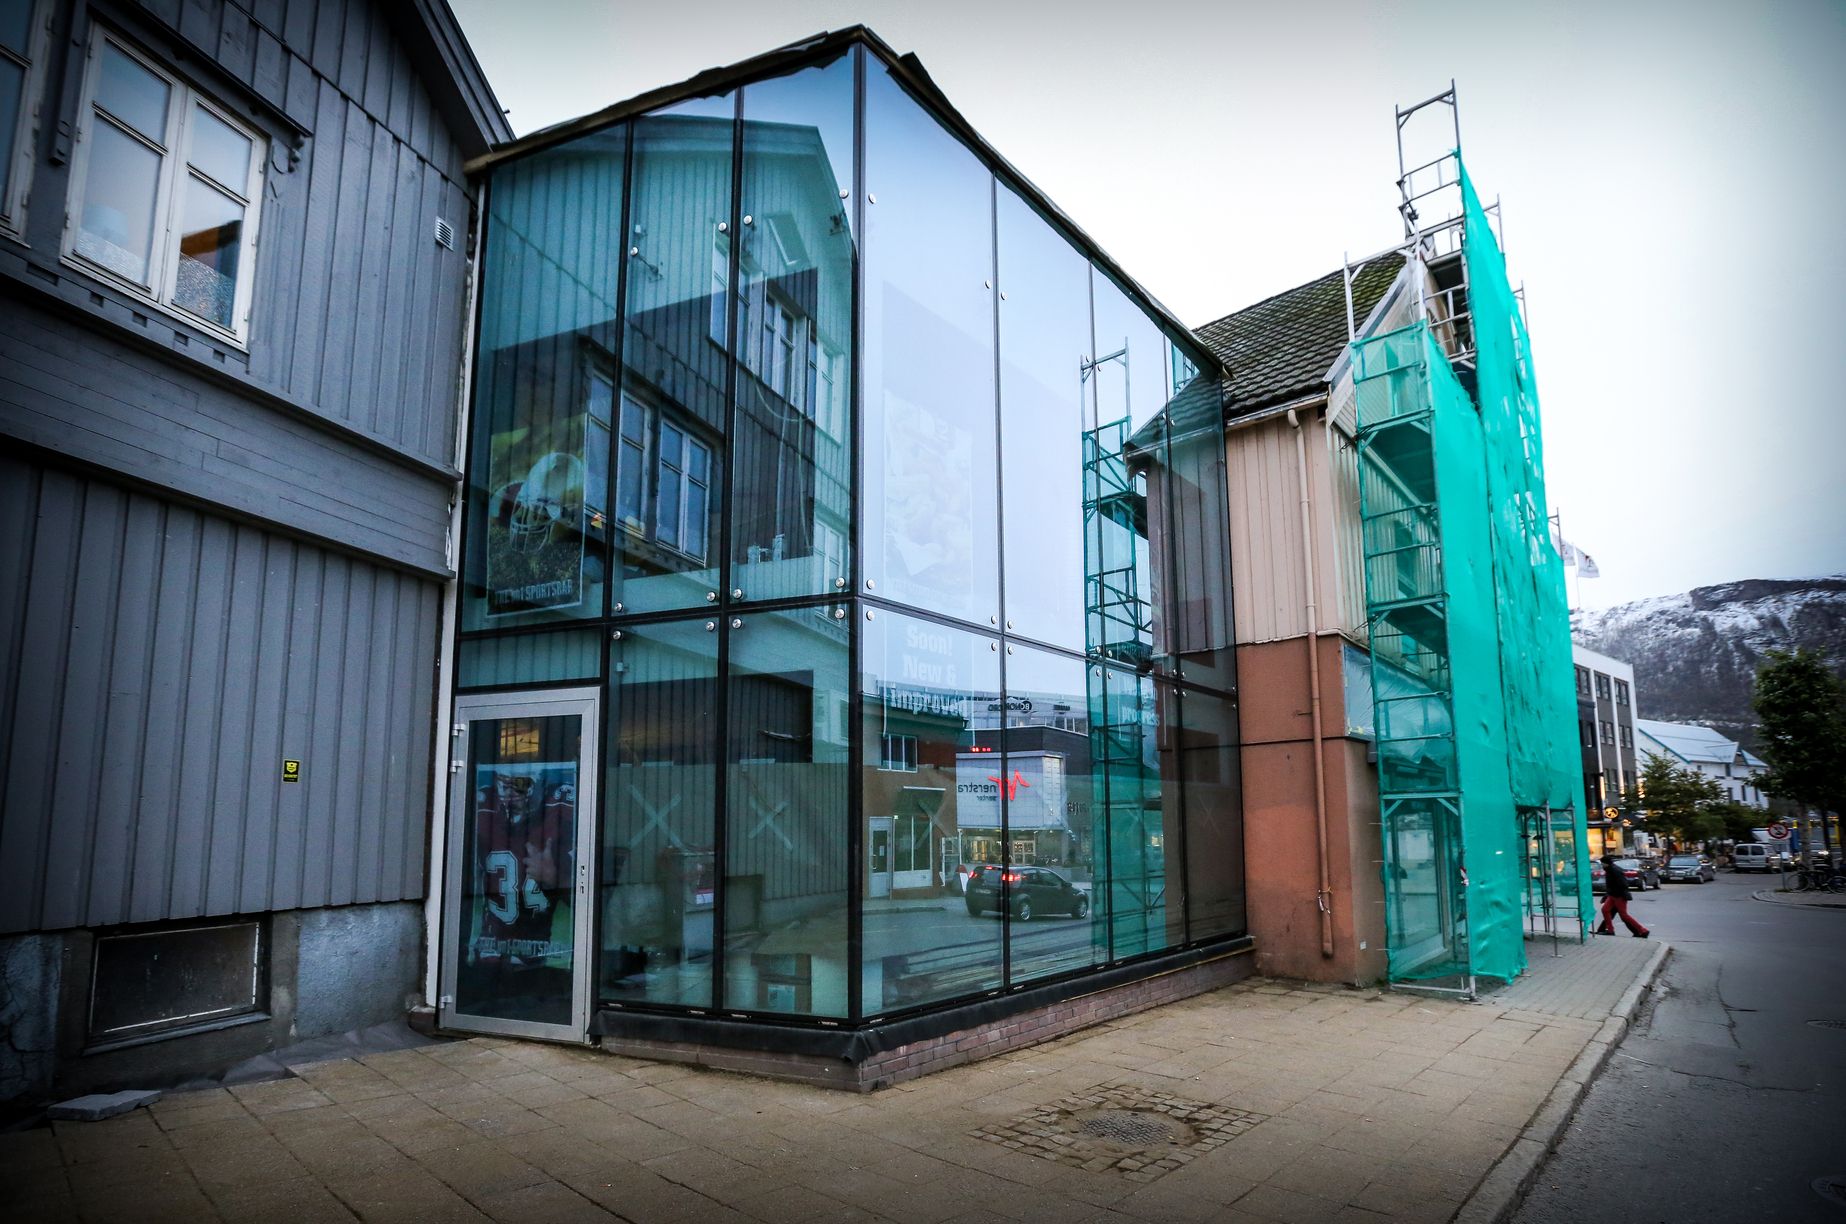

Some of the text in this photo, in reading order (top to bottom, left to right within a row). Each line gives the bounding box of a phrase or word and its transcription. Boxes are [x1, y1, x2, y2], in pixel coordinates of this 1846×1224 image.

[906, 625, 953, 657] Soon!
[903, 654, 957, 687] New &
